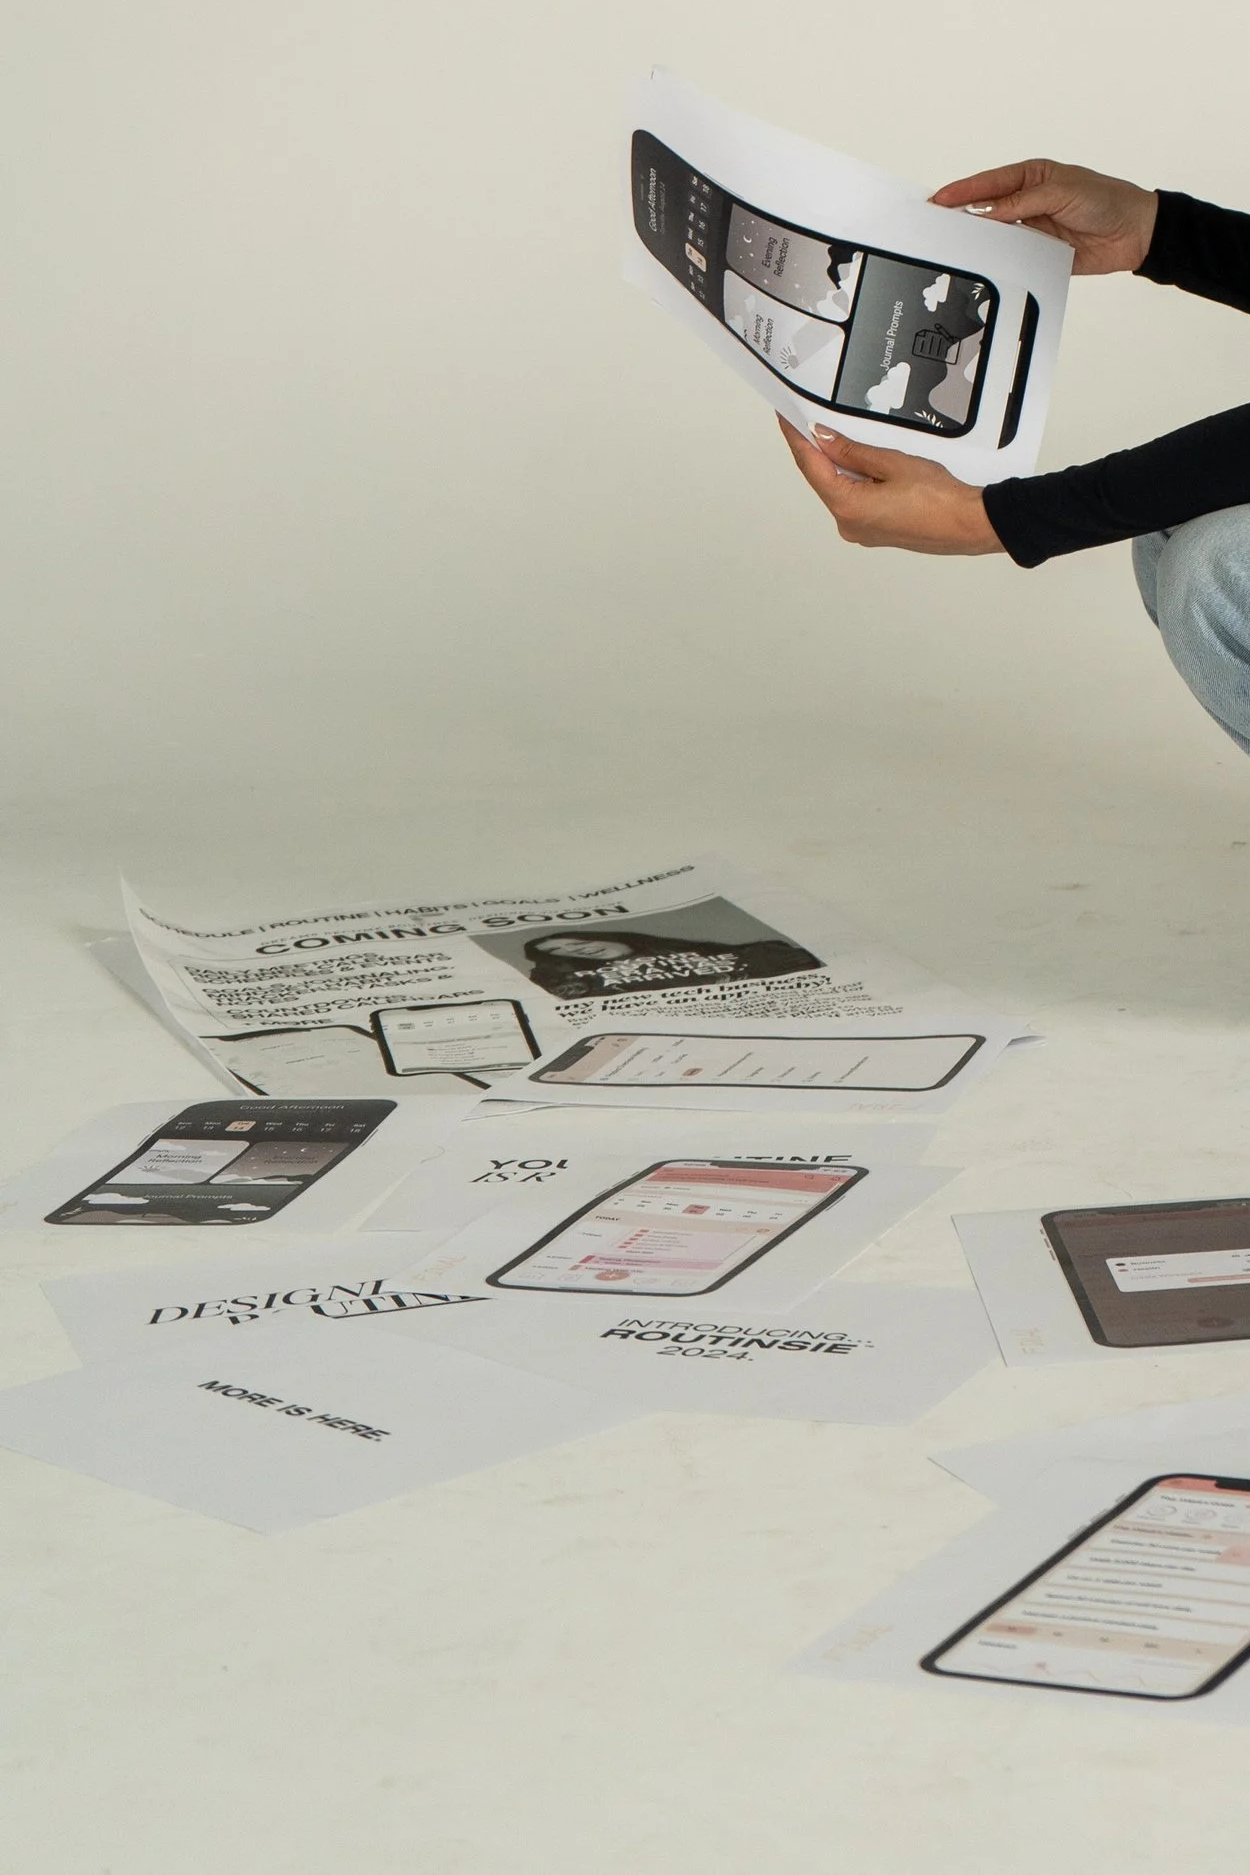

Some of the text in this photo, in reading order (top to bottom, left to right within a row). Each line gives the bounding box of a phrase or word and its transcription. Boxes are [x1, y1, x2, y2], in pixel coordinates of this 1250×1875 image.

[648, 167, 658, 232] Good Afternoon
[762, 237, 778, 268] Evening
[774, 237, 790, 277] Reflection
[753, 314, 763, 345] Morning
[762, 318, 774, 356] Reflection
[880, 301, 904, 371] Journal Prompts
[269, 912, 371, 929] ROUTINE
[384, 903, 468, 916] HABITS
[483, 898, 560, 906] GOALS
[577, 865, 695, 899] WELLNESS
[256, 924, 468, 955] COMING
[482, 905, 630, 928] SOON
[185, 965, 252, 976] DAILY
[193, 969, 335, 985] SCHEDULES
[360, 956, 453, 969] EVENTS
[317, 953, 445, 970] CALENDAR
[324, 976, 393, 987] HABIT
[353, 978, 432, 990] TASKS
[216, 996, 299, 1007] NOTES
[555, 1001, 595, 1011] my
[604, 995, 652, 1005] new
[661, 988, 712, 998] tech
[560, 1009, 593, 1018] we
[602, 1001, 658, 1012] have
[666, 997, 697, 1005] an
[766, 977, 832, 992] baby!
[231, 1007, 332, 1019] SHARED
[260, 1018, 334, 1026] MORE
[470, 1172, 515, 1183] IS
[617, 1318, 874, 1344] INTRODUCING...
[656, 1345, 754, 1362] 2024.
[198, 1380, 392, 1444] MORE IS HERE.
